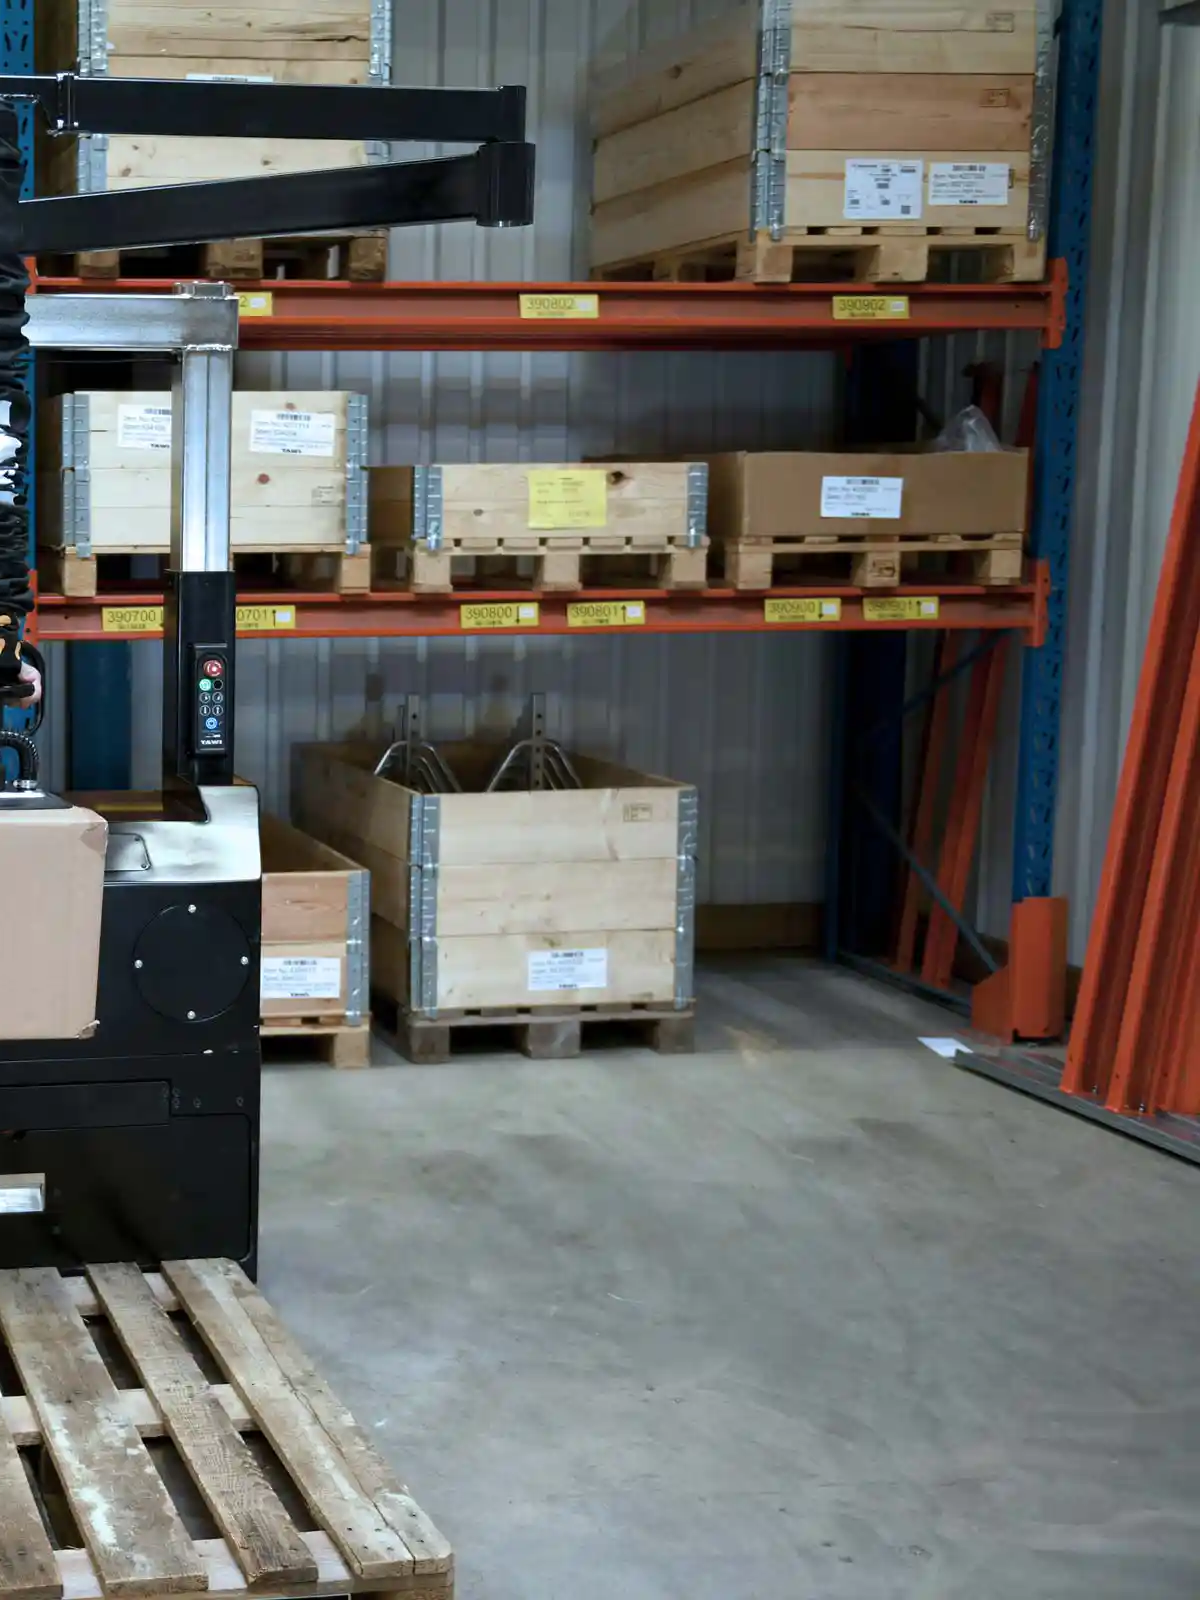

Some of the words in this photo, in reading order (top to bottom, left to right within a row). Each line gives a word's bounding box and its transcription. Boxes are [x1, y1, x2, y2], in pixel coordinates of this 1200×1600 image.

[526, 297, 574, 310] 390802
[839, 298, 886, 311] 390902
[108, 609, 156, 623] 390700
[237, 609, 268, 622] 0701
[465, 606, 513, 619] 390800
[572, 605, 618, 618] 390801
